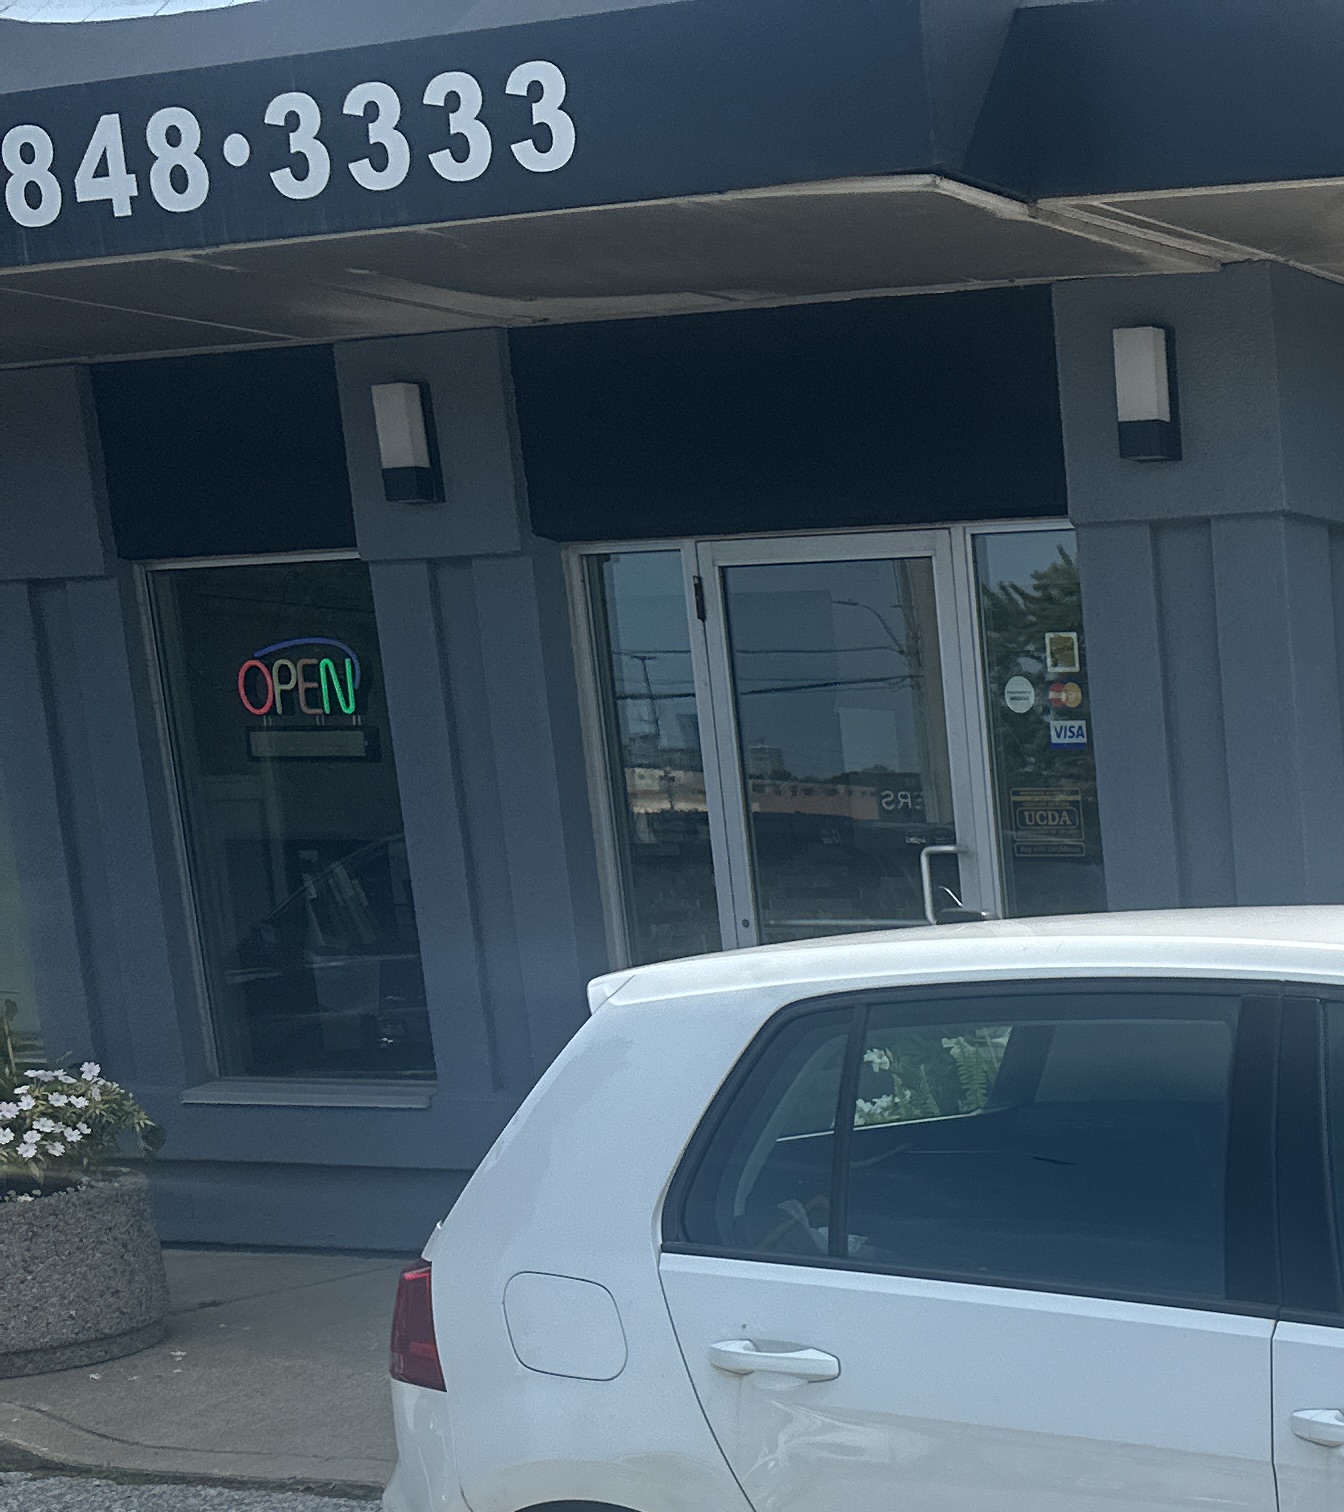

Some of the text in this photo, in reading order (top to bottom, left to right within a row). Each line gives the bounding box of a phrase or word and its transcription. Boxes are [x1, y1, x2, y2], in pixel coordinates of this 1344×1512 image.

[238, 657, 356, 716] OPEN
[1054, 725, 1085, 740] VISA
[1024, 810, 1072, 827] UCDA
